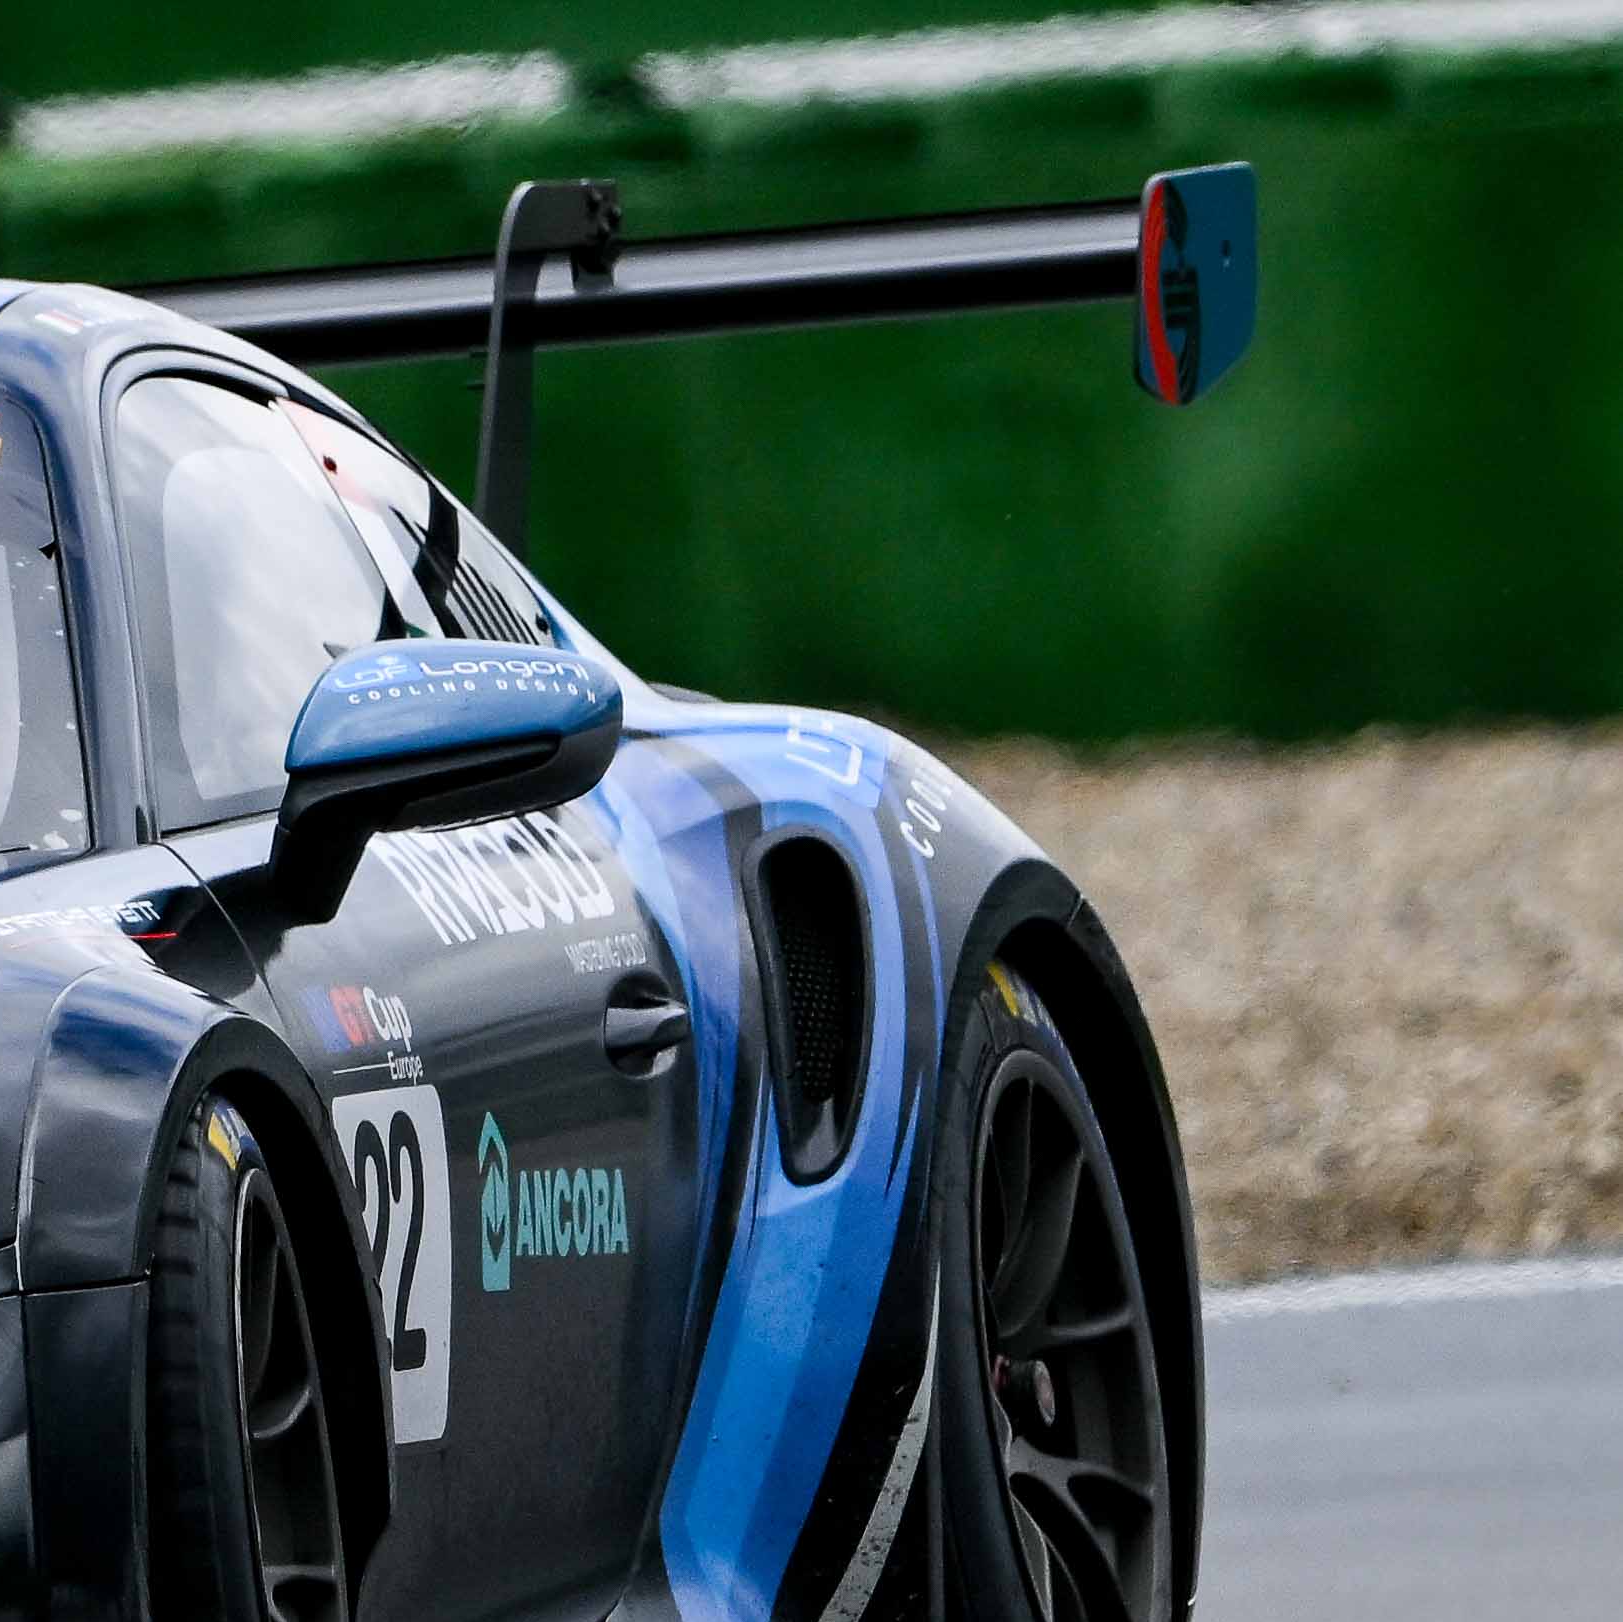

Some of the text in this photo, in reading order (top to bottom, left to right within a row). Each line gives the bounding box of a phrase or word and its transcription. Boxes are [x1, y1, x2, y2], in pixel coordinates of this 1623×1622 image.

[348, 678, 596, 705] COOLING DESIGN
[419, 659, 589, 681] Longoni
[362, 986, 413, 1053] Cup
[387, 1050, 424, 1086] Europe
[516, 1168, 630, 1257] ANCORA
[355, 1110, 427, 1372] 22
